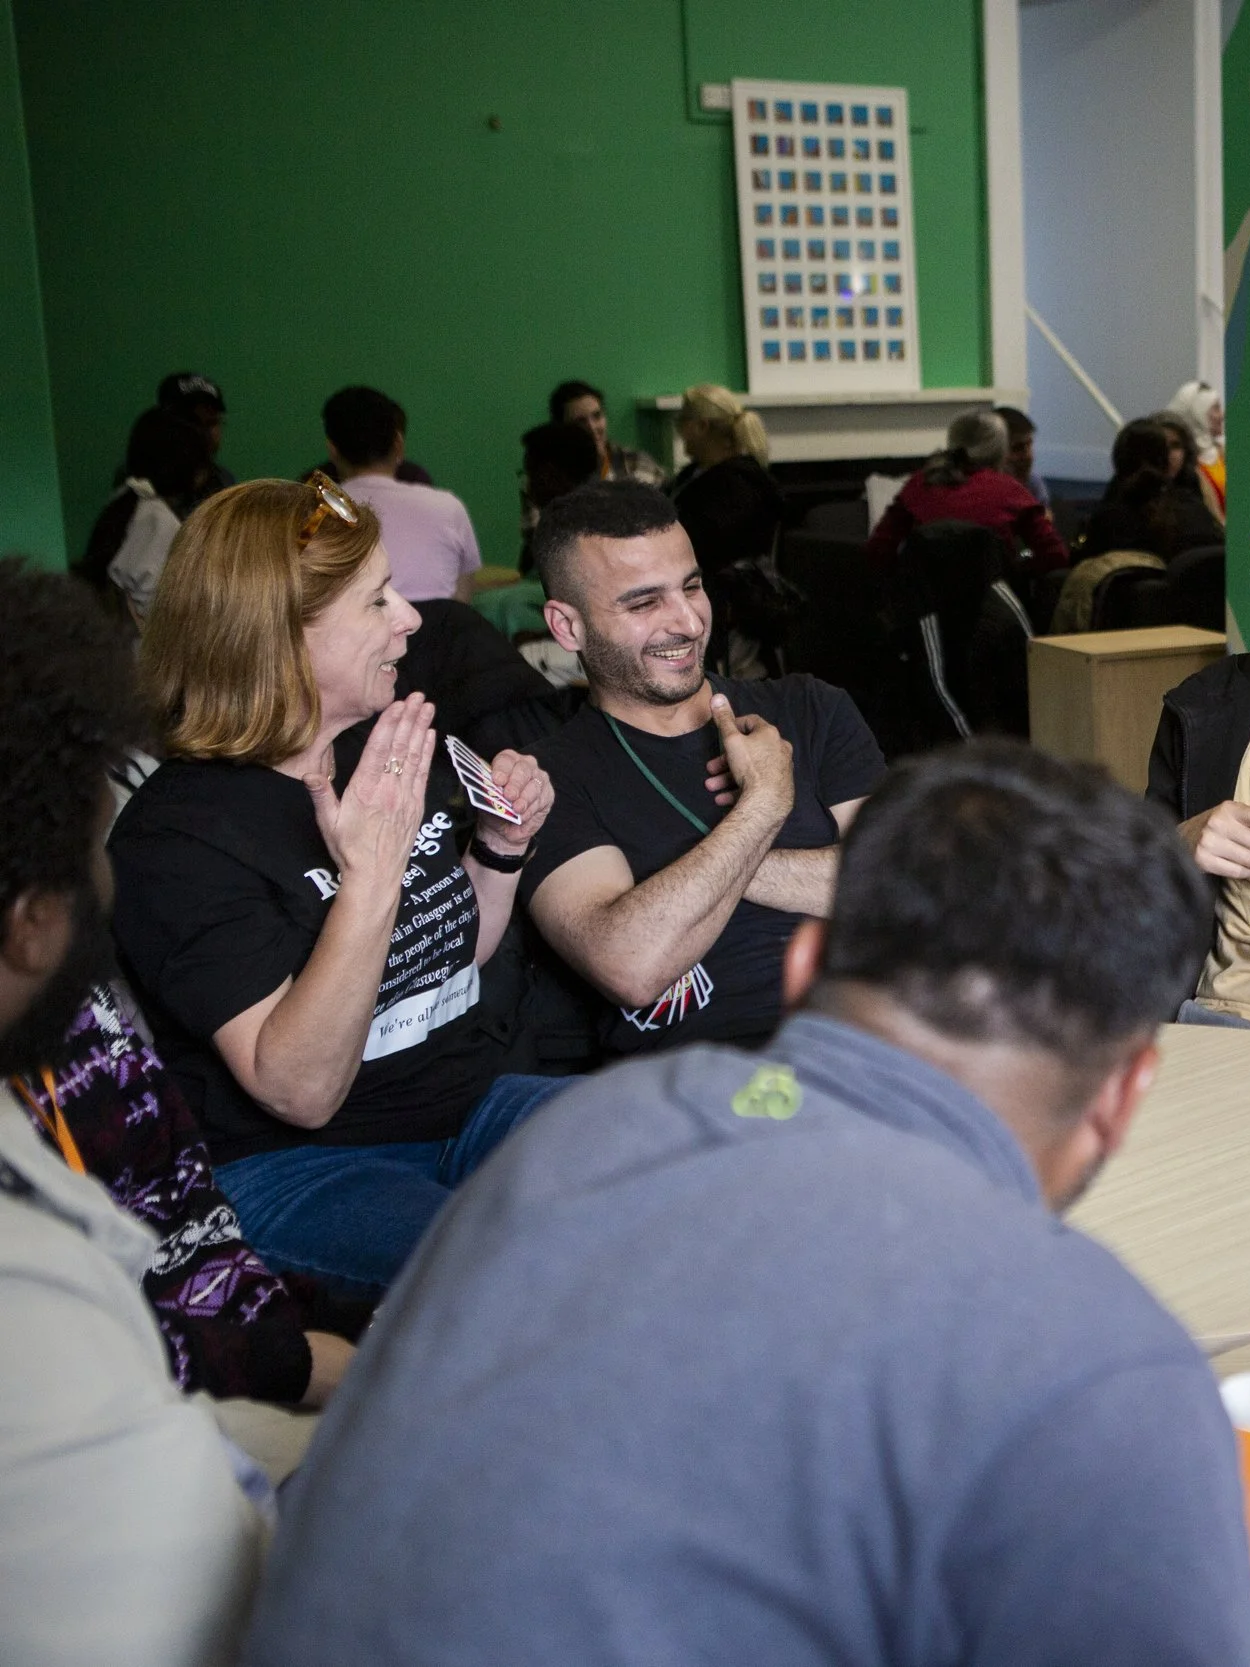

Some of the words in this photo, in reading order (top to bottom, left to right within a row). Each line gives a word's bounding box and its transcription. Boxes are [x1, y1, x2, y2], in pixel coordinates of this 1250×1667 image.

[409, 894, 424, 906] A
[420, 876, 453, 903] person
[400, 923, 414, 935] in
[411, 899, 453, 929] Glasgow
[451, 893, 463, 905] is
[378, 958, 424, 992] onsidered
[442, 932, 465, 954] local
[387, 952, 404, 968] the
[404, 935, 434, 963] people
[433, 924, 443, 941] of
[444, 919, 457, 933] the
[379, 1017, 414, 1039] We're
